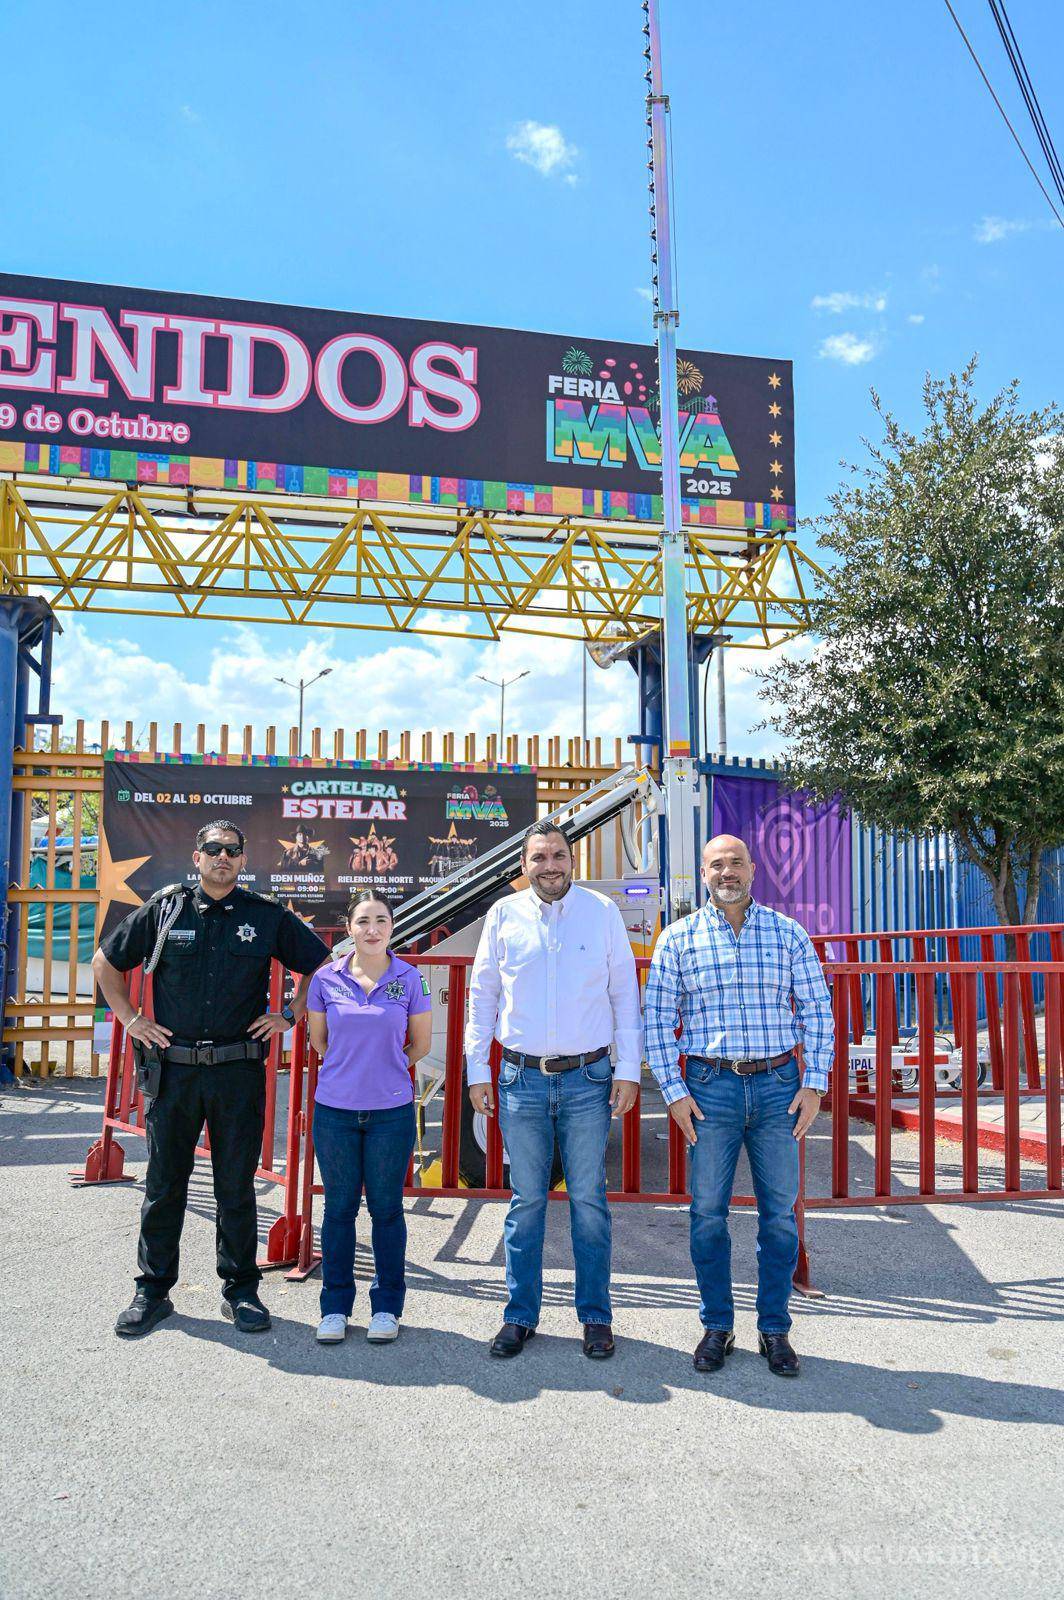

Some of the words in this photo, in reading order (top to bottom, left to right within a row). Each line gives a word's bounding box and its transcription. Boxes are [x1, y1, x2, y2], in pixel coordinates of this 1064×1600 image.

[548, 375, 621, 402] FERIA
[23, 404, 62, 433] de
[68, 408, 191, 445] Octubre
[686, 479, 732, 496] 2025
[291, 780, 398, 799] CARTELERA
[134, 792, 154, 803] DEL
[156, 793, 171, 803] 02
[172, 793, 187, 804] AL
[189, 794, 201, 804] 19
[203, 794, 252, 806] OCTUBRE
[282, 798, 407, 820] ESTELAR
[446, 800, 509, 820] MVA
[270, 874, 293, 883] EDEN
[293, 872, 325, 883] MUÑOZ
[337, 875, 373, 884] RIELEROS
[374, 876, 388, 884] DEL
[388, 876, 414, 884] NORTE
[848, 1058, 874, 1070] IPAL
